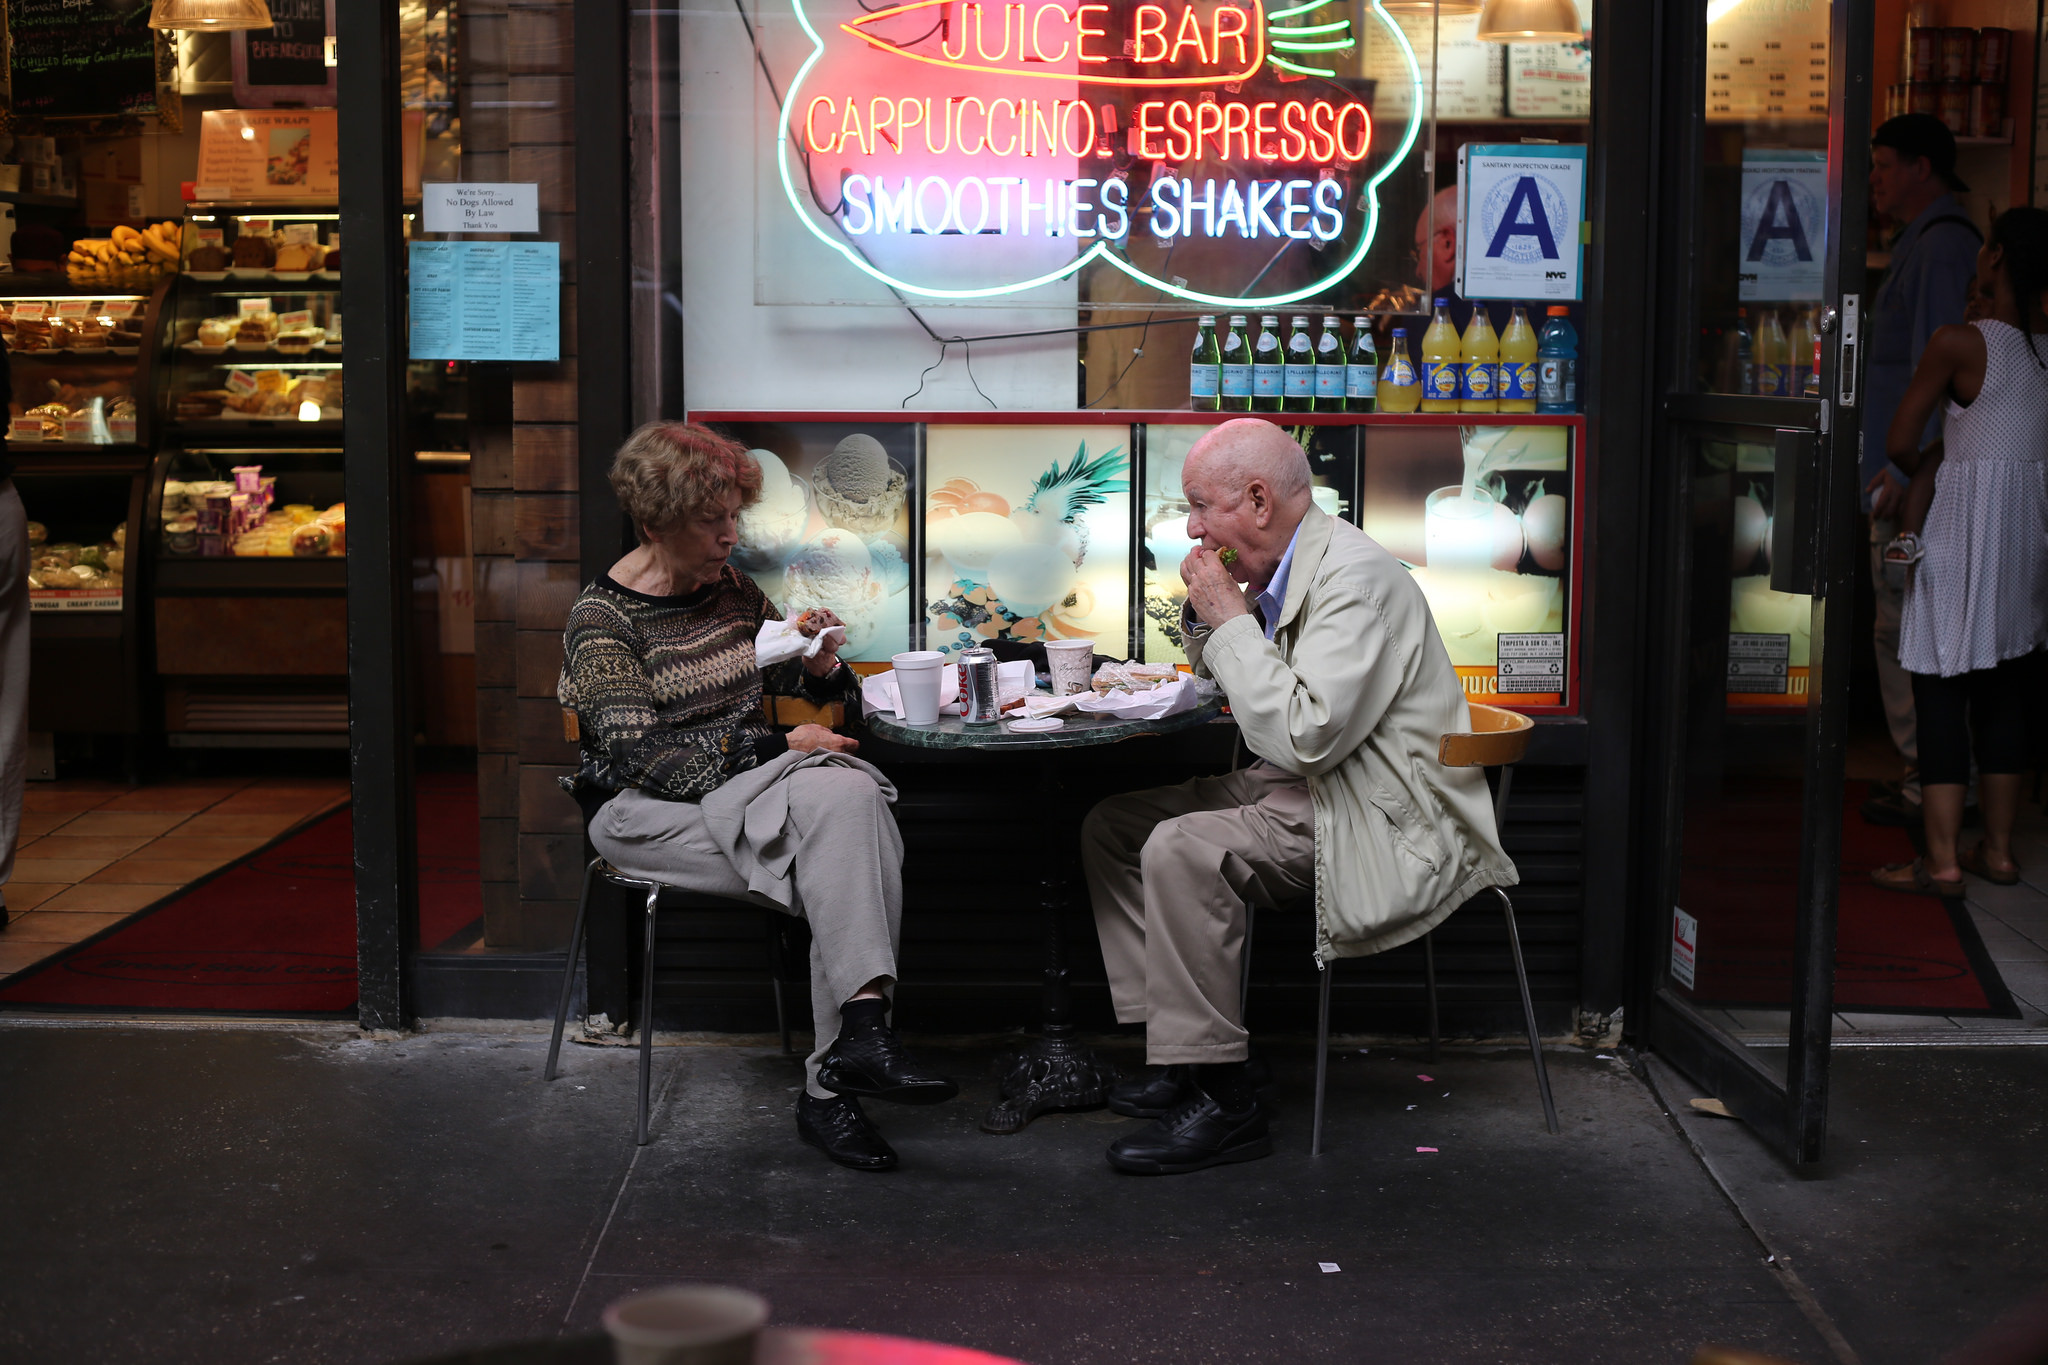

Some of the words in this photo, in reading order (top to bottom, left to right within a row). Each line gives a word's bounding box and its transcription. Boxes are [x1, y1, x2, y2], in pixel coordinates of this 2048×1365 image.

[942, 2, 1109, 62] JUICE
[1134, 4, 1247, 64] BAR
[1139, 100, 1373, 162] ESPRESSO
[460, 199, 480, 208] Dogs
[465, 209, 477, 219] By
[478, 209, 495, 217] Law
[842, 174, 1129, 240] SMOOTHIES
[1150, 177, 1344, 241] SHAKES
[1485, 176, 1560, 260] A
[1545, 271, 1567, 279] NYC
[1541, 362, 1557, 384] G
